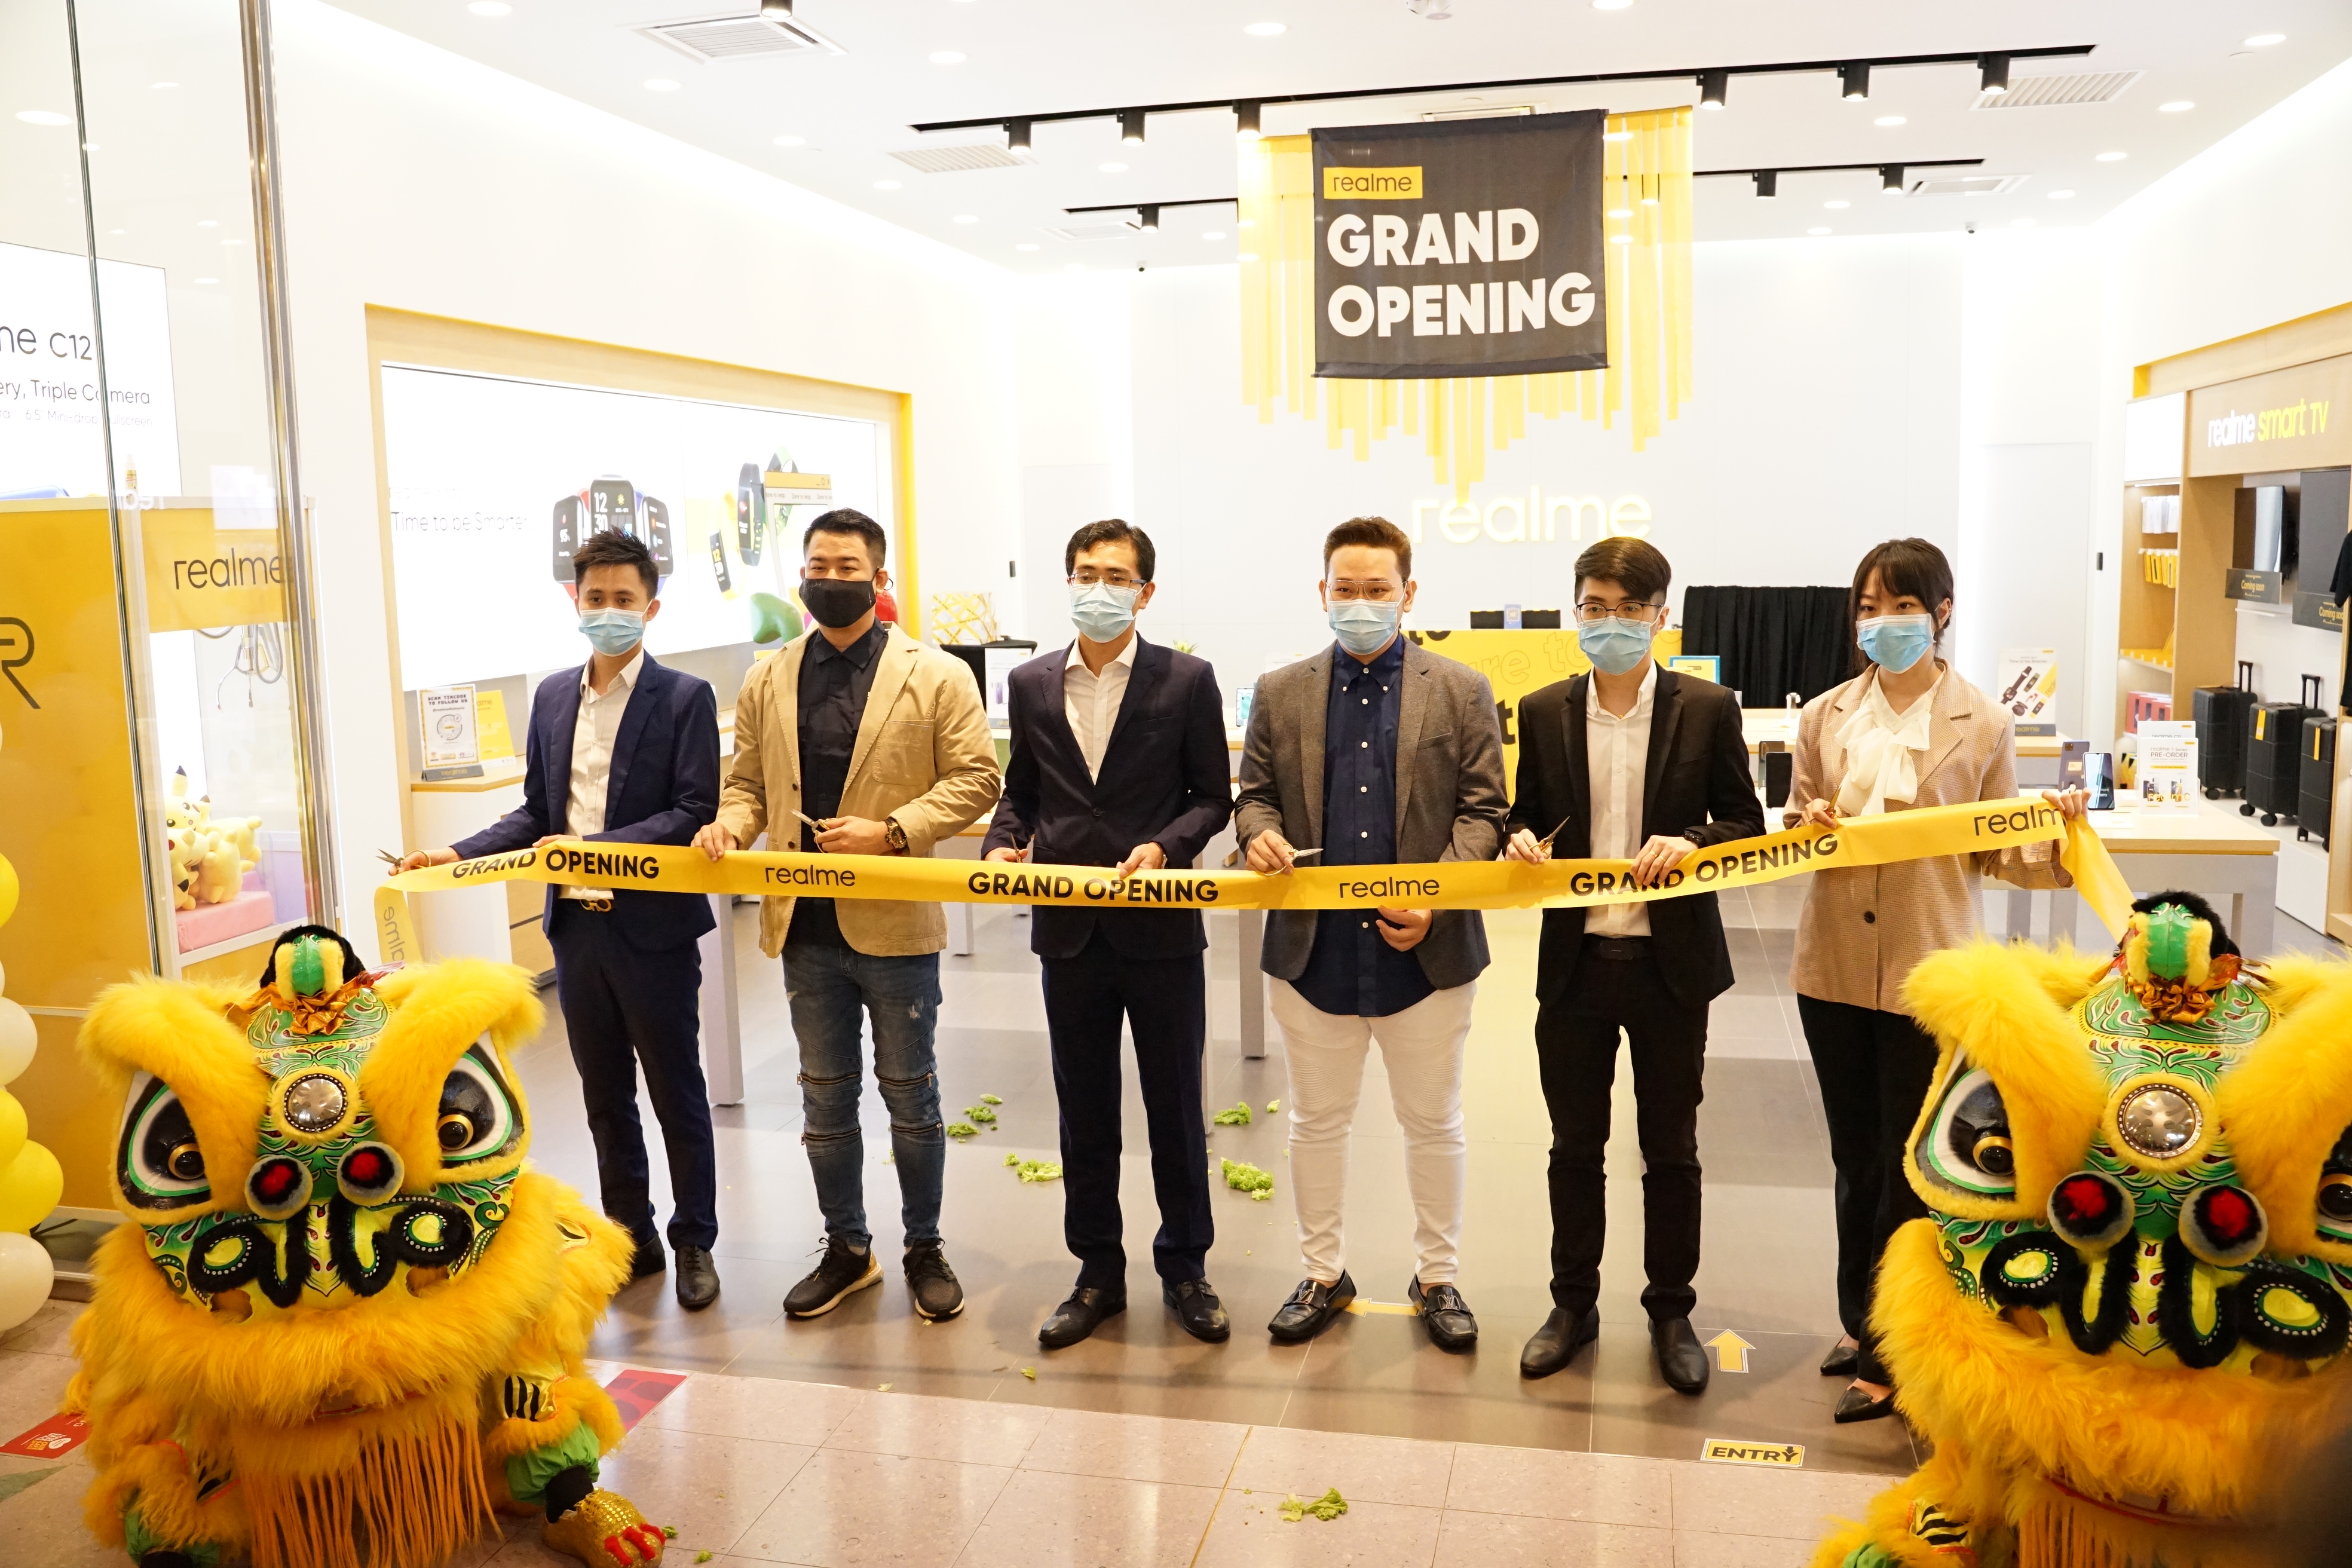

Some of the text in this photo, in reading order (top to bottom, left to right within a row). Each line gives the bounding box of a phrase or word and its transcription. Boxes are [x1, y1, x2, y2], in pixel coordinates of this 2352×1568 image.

[1333, 172, 1412, 192] realme
[1327, 207, 1540, 267] GRAND
[1327, 271, 1596, 338] OPENING
[50, 332, 93, 361] C12
[30, 379, 77, 403] Triple
[48, 410, 99, 426] Mini-drop
[109, 414, 153, 427] ullscreen
[2208, 398, 2329, 448] realme smart TV
[594, 492, 608, 513] 12
[1411, 484, 1652, 544] realme
[391, 512, 428, 531] Time
[433, 514, 448, 531] to
[452, 513, 470, 531] be
[2319, 606, 2336, 621] Coming
[1973, 805, 2062, 837] realm
[452, 849, 660, 880] GRAND OPENING
[1695, 833, 1839, 883] OPENING
[764, 863, 856, 887] realme
[968, 871, 1219, 902] GRAND OPENING
[1339, 875, 1441, 899] realme
[1711, 1446, 1799, 1462] ENTRY
